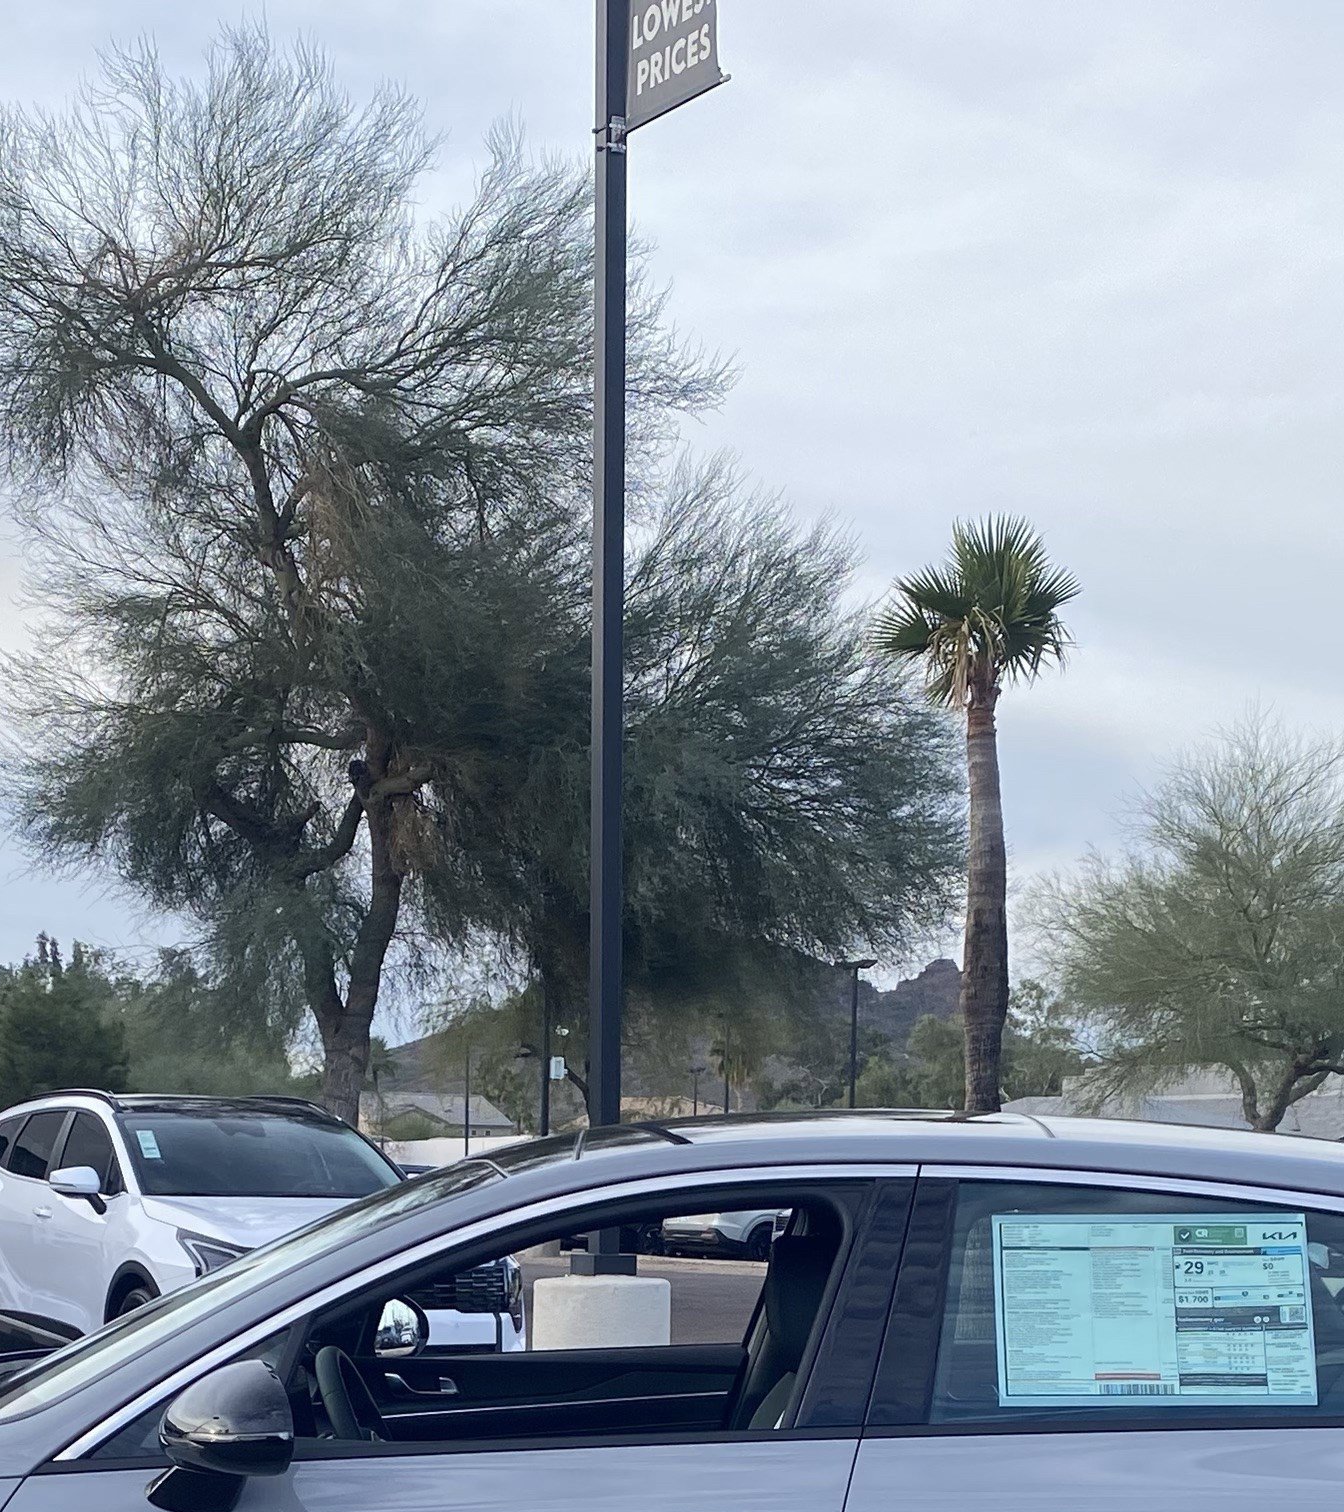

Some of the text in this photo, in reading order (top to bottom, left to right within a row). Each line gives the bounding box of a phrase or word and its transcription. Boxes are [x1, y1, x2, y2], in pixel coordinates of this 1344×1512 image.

[633, 0, 711, 50] LOWE
[636, 23, 711, 95] PRICES
[1262, 1231, 1297, 1240] KIA
[1184, 1261, 1204, 1274] 29
[1262, 1262, 1274, 1270] $0
[1178, 1295, 1209, 1304] $1700
